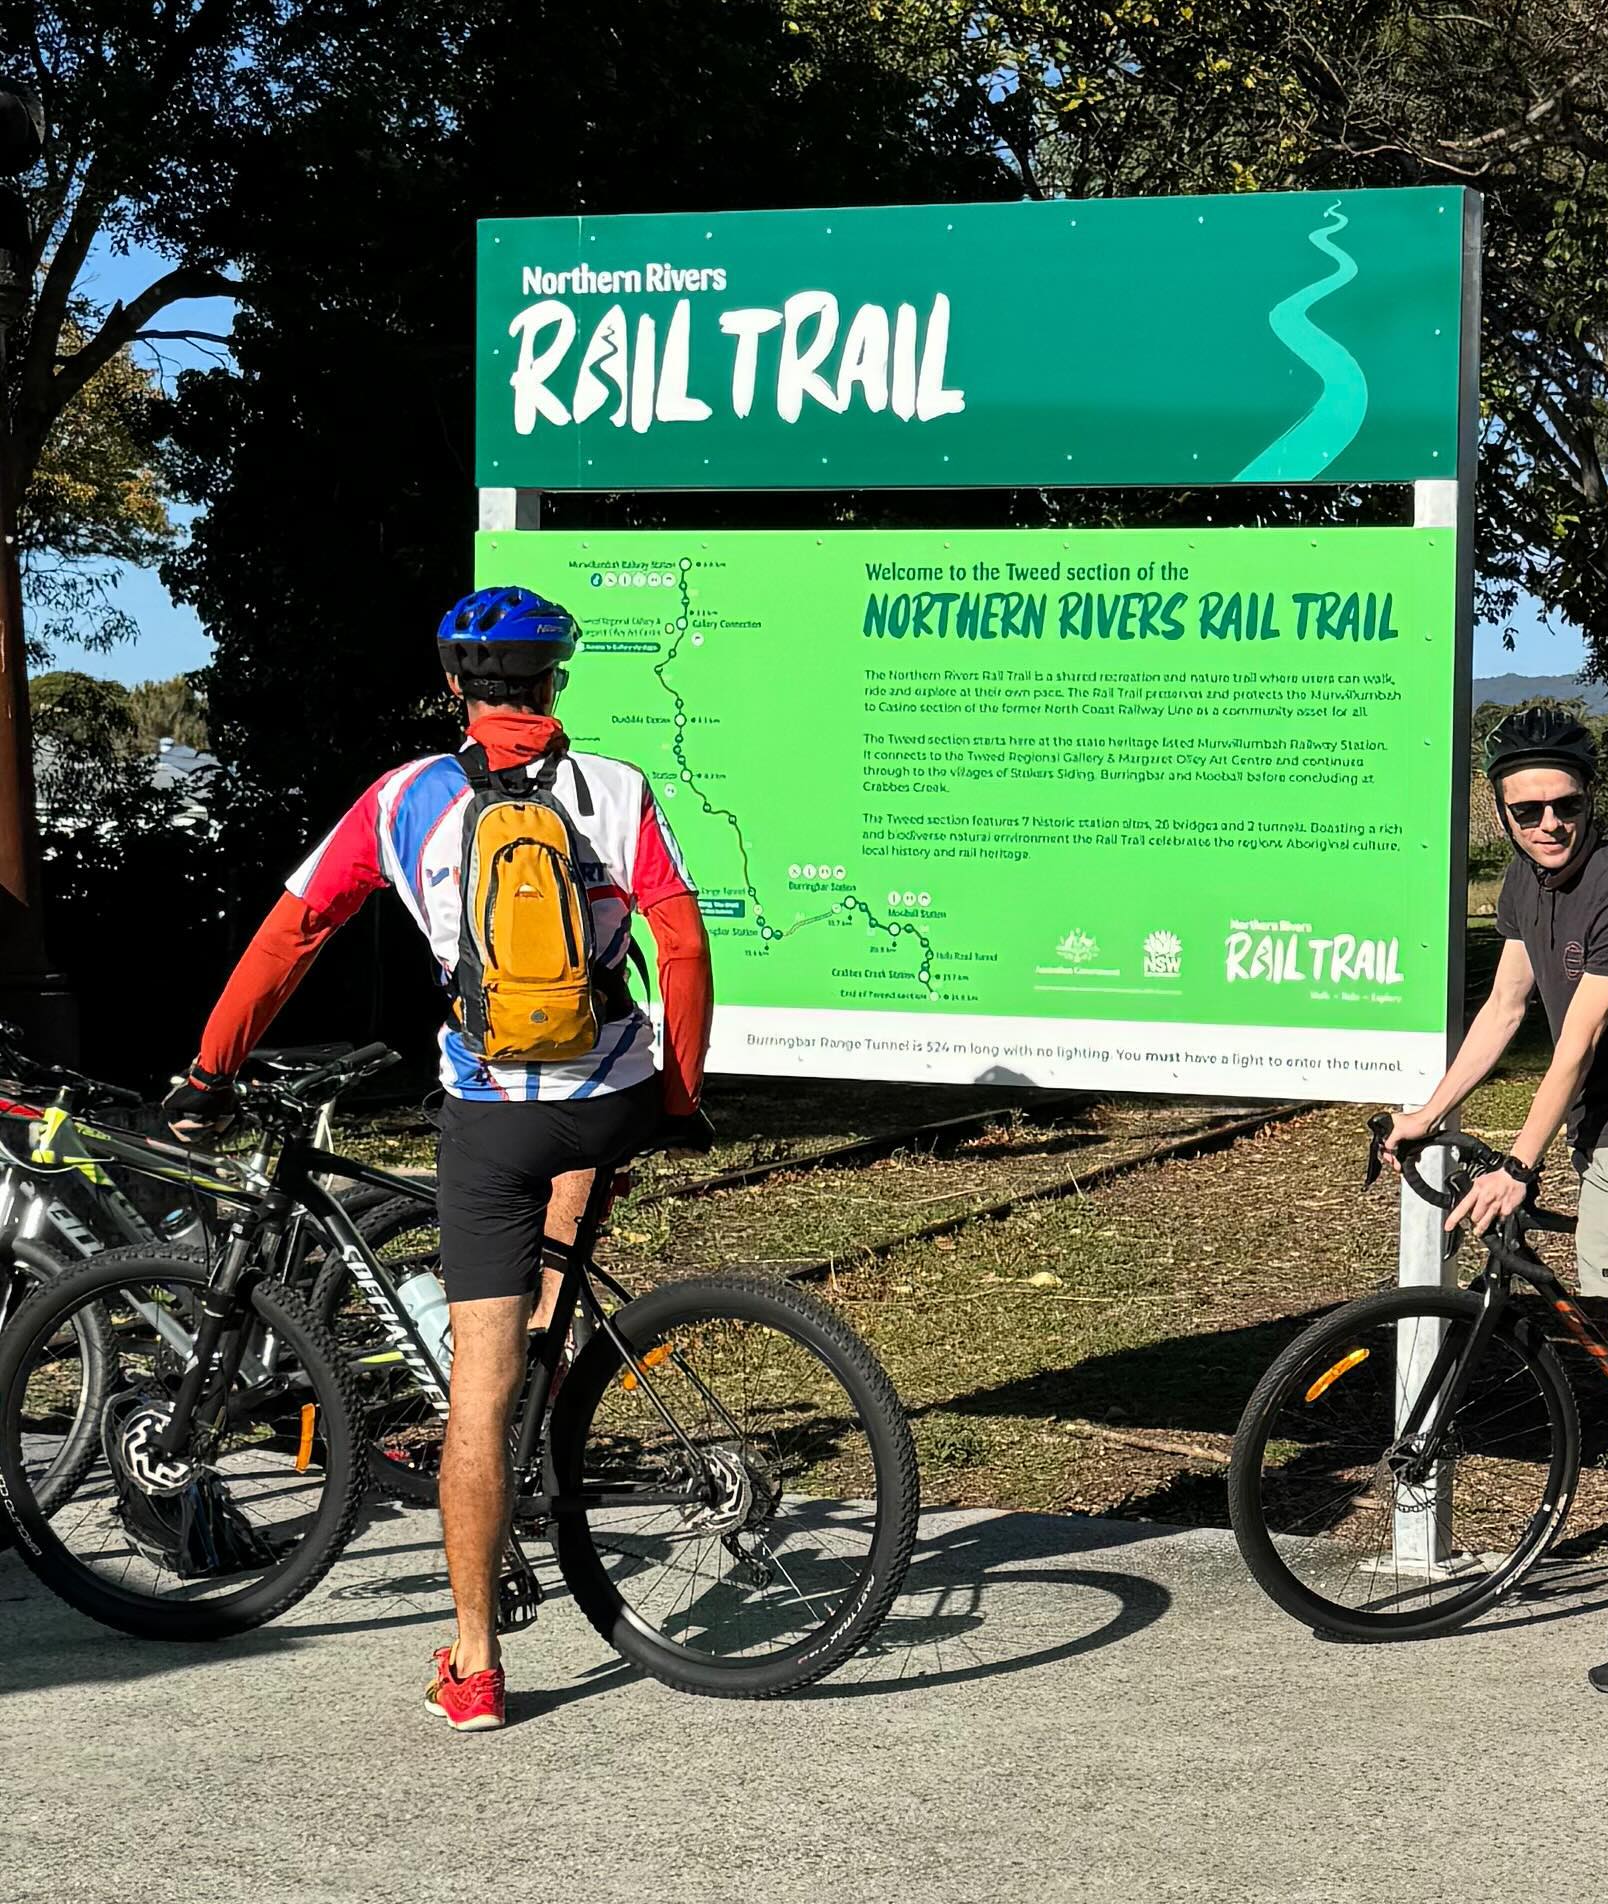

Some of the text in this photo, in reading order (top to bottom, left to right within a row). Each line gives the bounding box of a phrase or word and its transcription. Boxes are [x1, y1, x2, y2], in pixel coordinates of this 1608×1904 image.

[523, 263, 727, 295] Northern Rivers
[509, 290, 966, 435] RAIL TRAIL
[865, 561, 1188, 580] Welcome to the Tweed section of the
[863, 591, 1399, 641] NORTHERN RIVERS RAIL TRAIL
[1144, 956, 1182, 973] NSW
[1225, 931, 1405, 984] RAIL TRAIL
[747, 1035, 815, 1047] Burringbar
[820, 1038, 861, 1050] Range
[865, 1039, 909, 1049] Tunnel
[970, 1043, 999, 1056] long
[1004, 1045, 1032, 1055] with
[1037, 1048, 1052, 1056] no
[1116, 1049, 1140, 1060] You
[1145, 1052, 1179, 1061] must
[1185, 1052, 1216, 1062] have
[1232, 1054, 1262, 1068] light
[1268, 1056, 1282, 1066] to
[1286, 1058, 1320, 1067] enter
[1327, 1058, 1349, 1069] the
